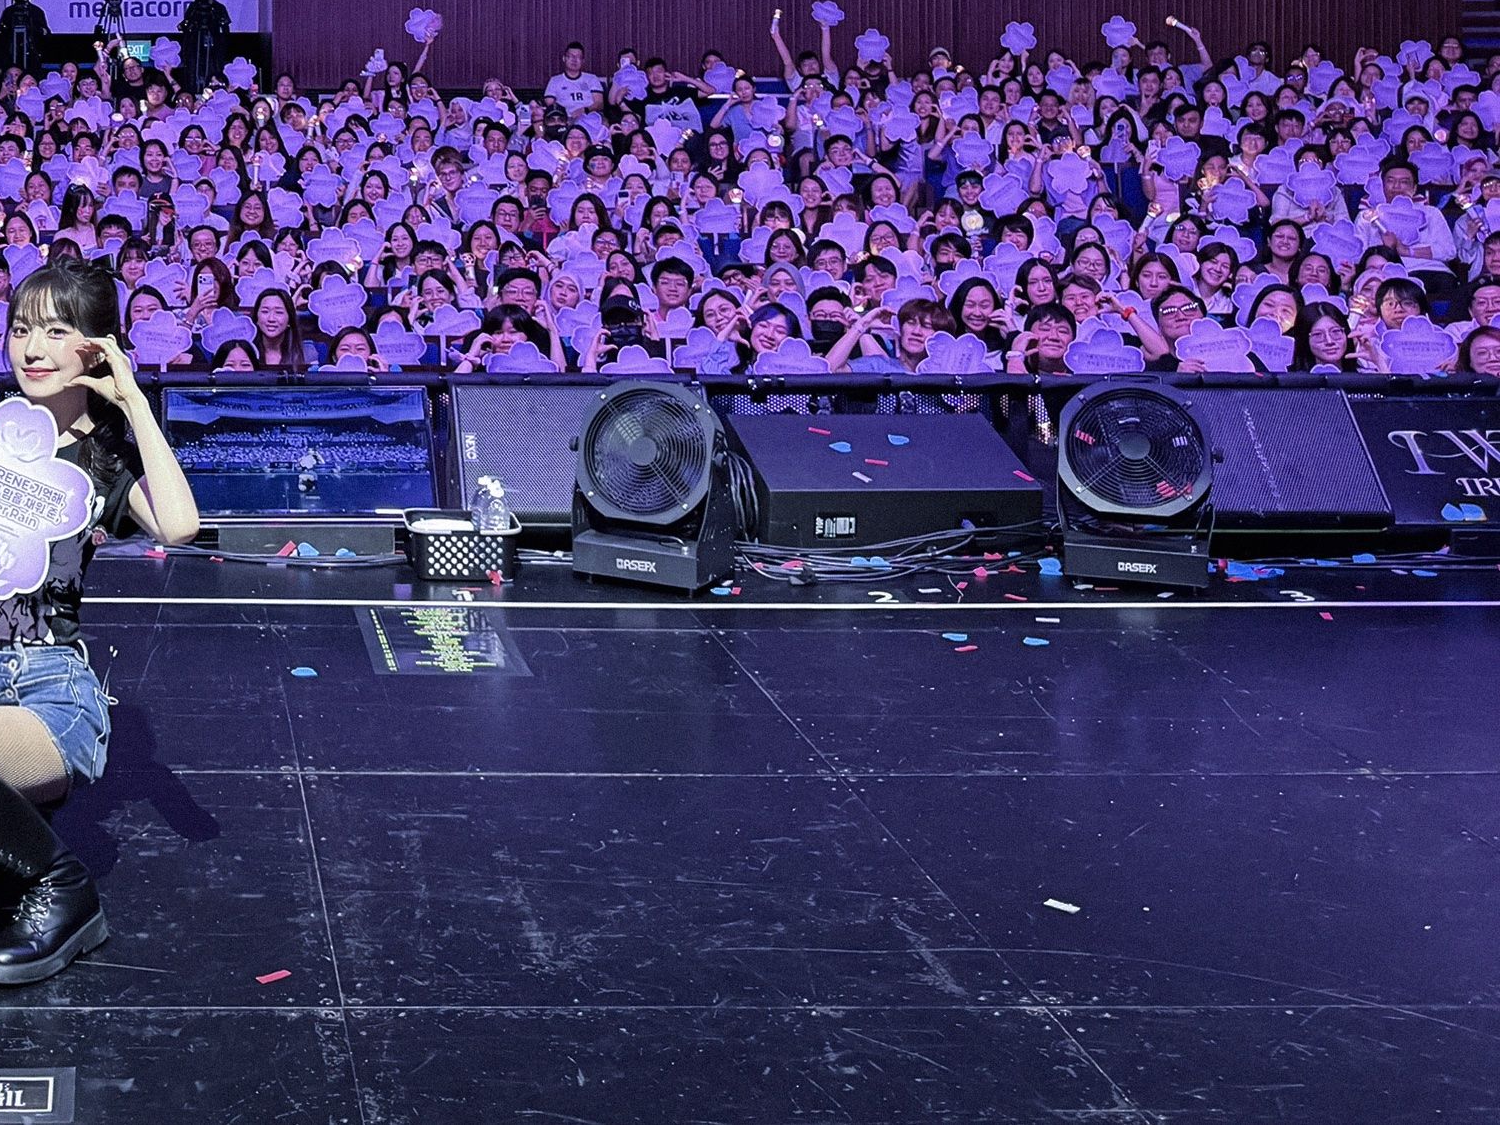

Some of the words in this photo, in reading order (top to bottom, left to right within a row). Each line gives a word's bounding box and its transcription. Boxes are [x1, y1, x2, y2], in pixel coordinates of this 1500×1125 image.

[9, 509, 38, 528] Rain
[868, 591, 899, 604] 2
[1280, 590, 1316, 602] 3
